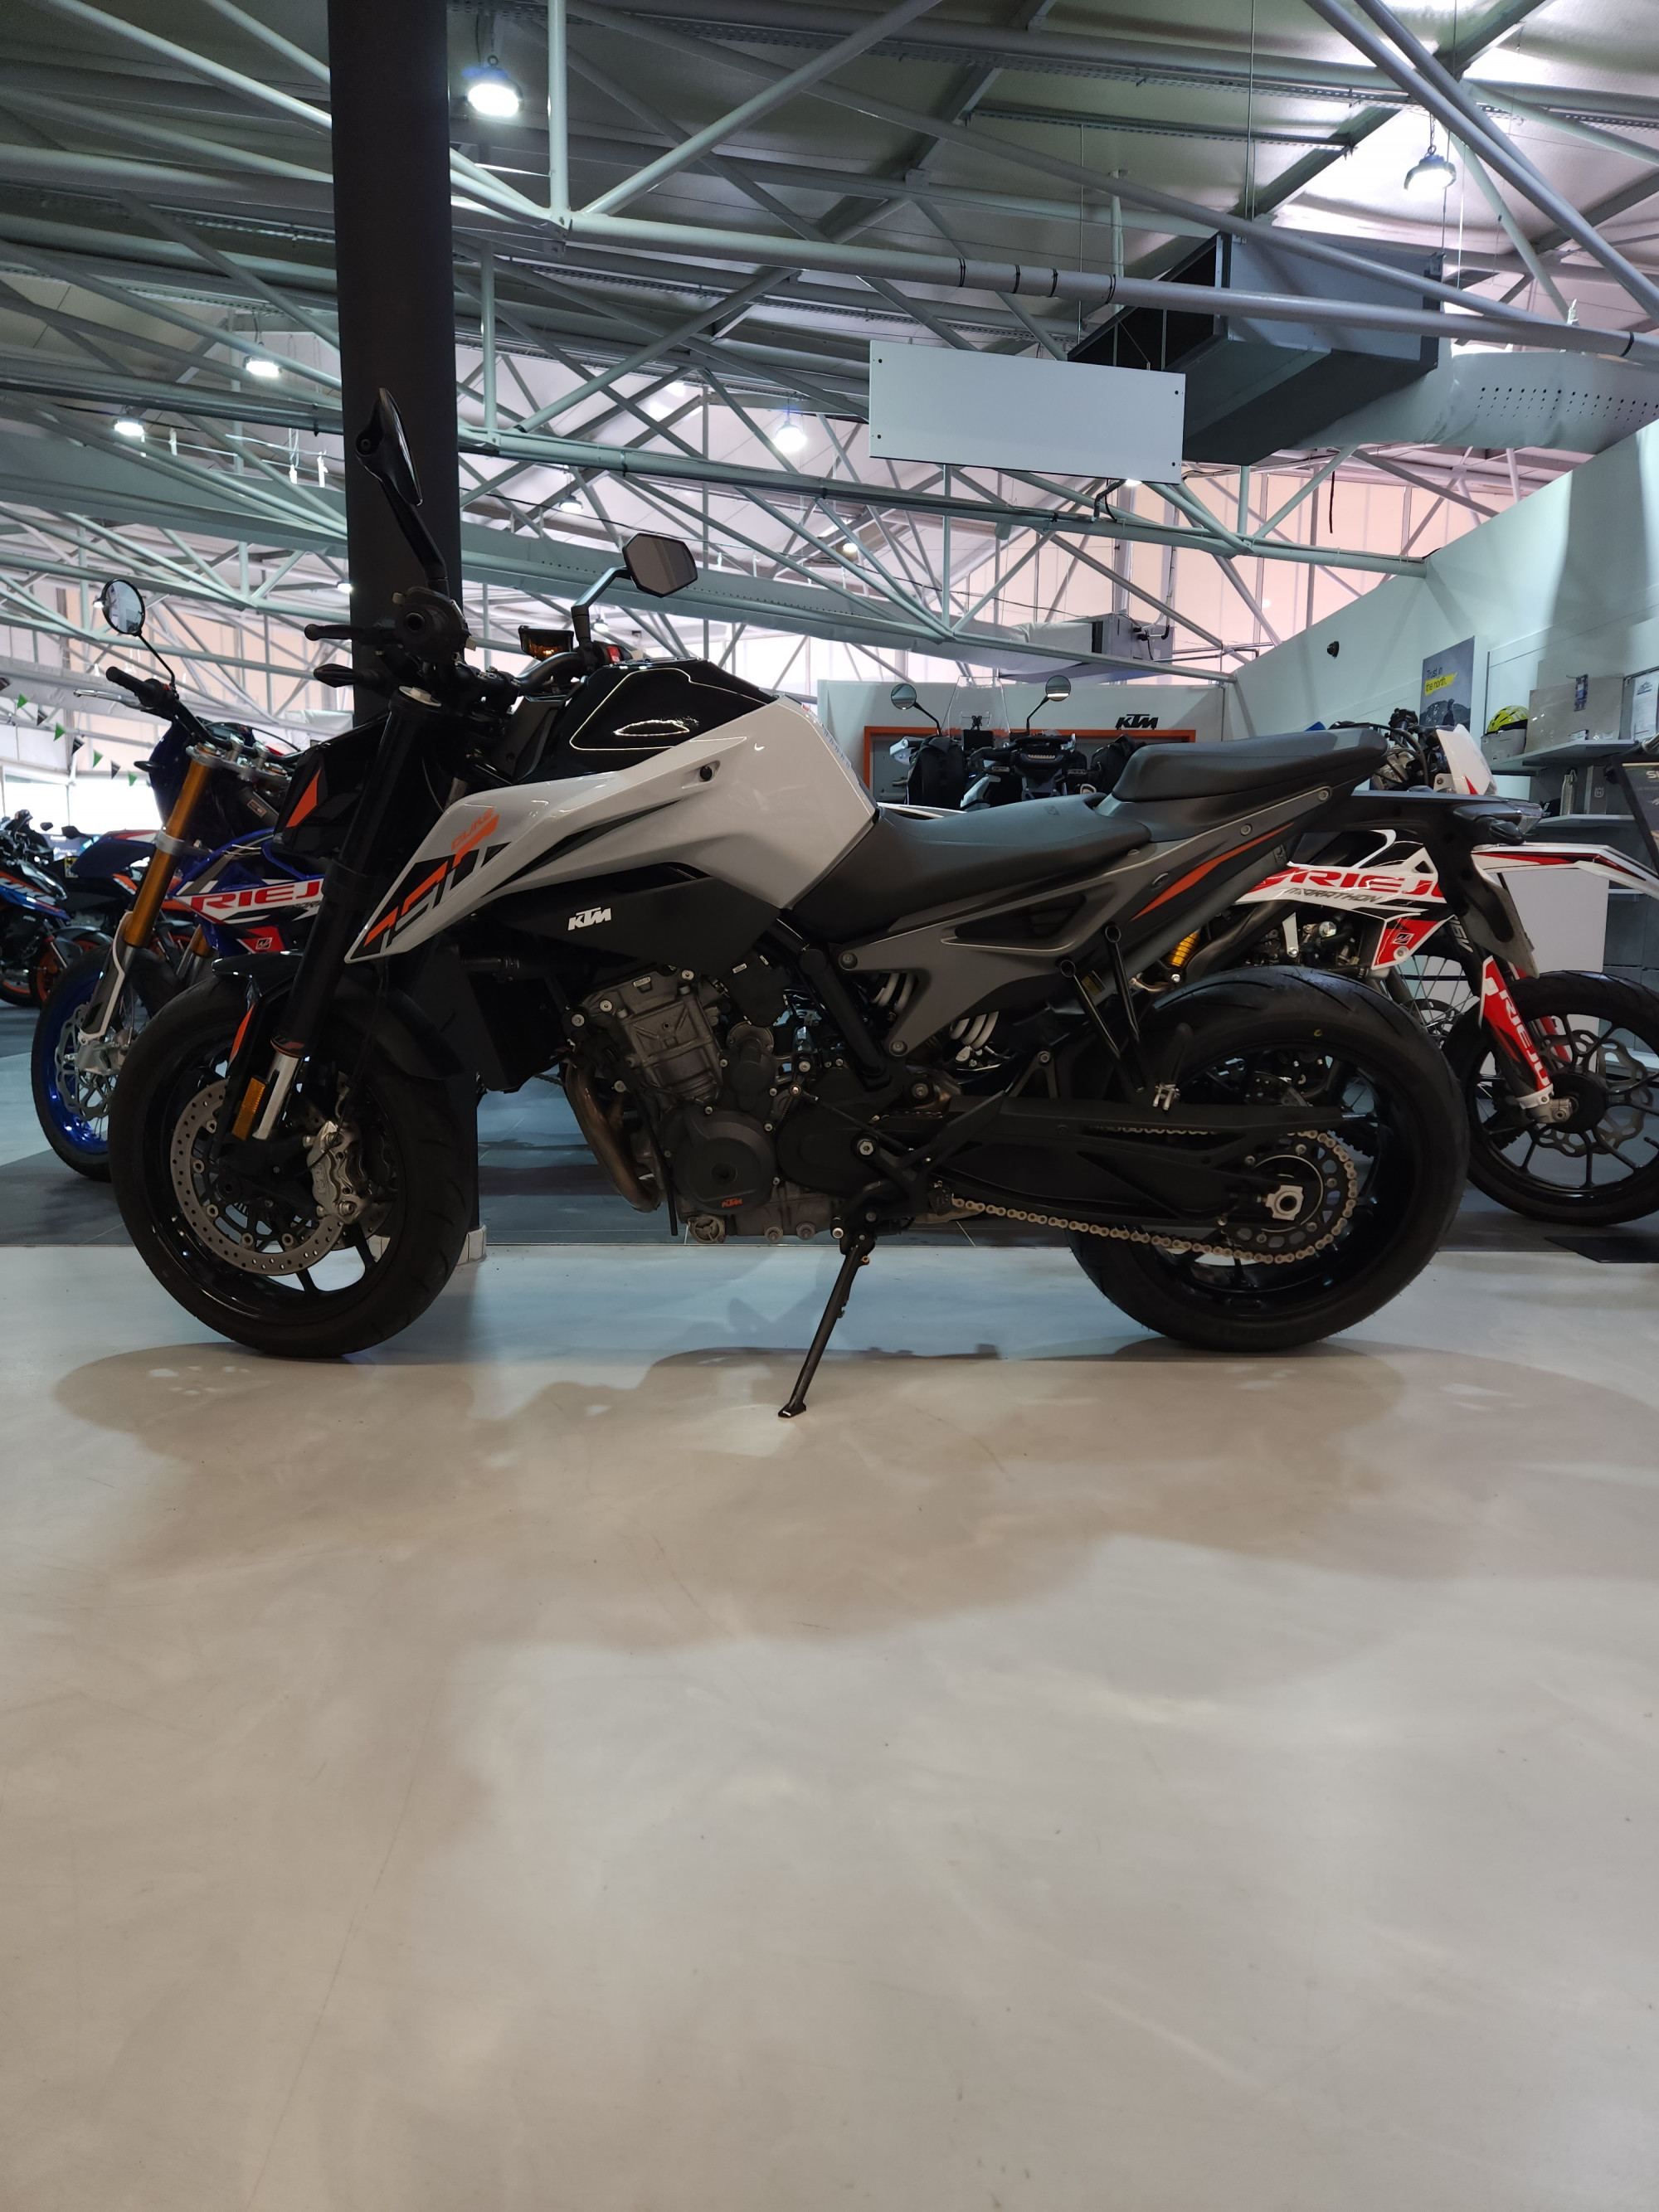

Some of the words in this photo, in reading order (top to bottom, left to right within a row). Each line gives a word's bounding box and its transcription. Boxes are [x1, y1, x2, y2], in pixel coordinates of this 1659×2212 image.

[1427, 667, 1438, 678] Trust
[1115, 713, 1159, 729] KTM
[450, 806, 495, 852] DUKE
[190, 881, 321, 912] RIEJ
[1284, 887, 1384, 903] MARATHON
[567, 907, 612, 931] KTM
[1498, 989, 1551, 1087] RIEJU
